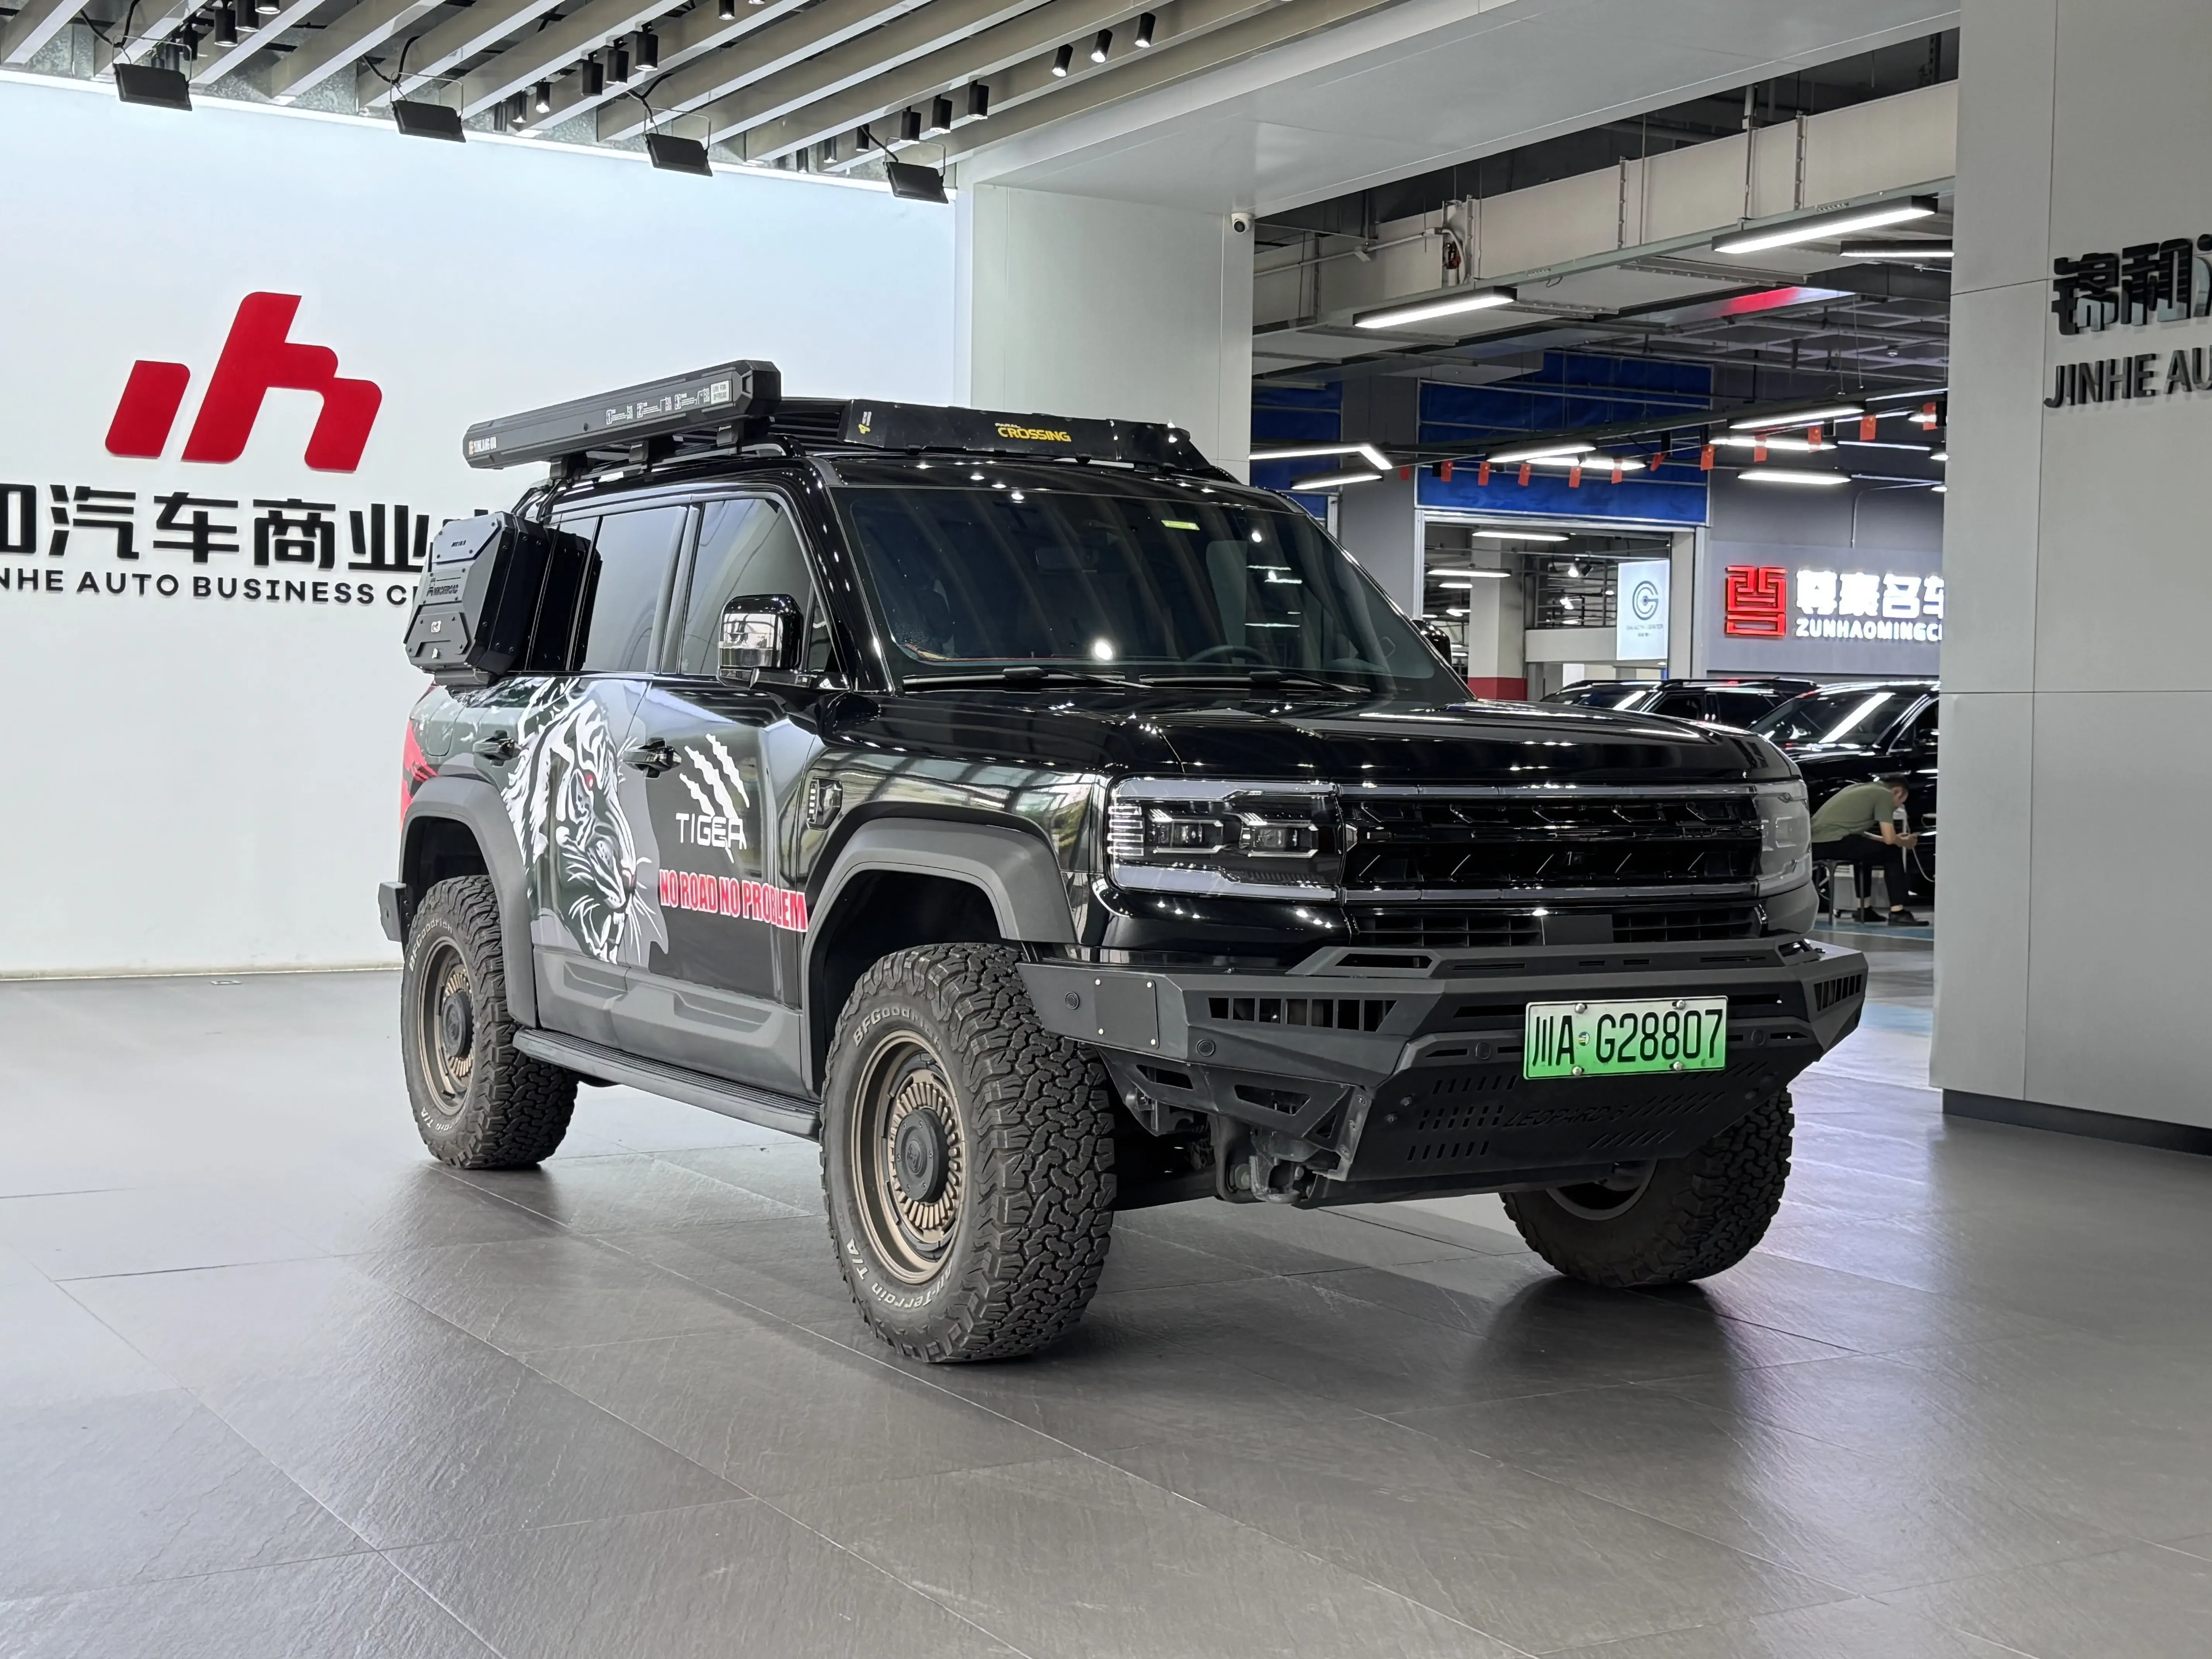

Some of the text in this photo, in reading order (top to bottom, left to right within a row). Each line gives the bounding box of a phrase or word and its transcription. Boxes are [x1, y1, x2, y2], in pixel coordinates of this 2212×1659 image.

[2044, 353, 2156, 408] JINHE
[998, 427, 1072, 442] CROSSING
[0, 483, 489, 573] 汽车商业
[77, 571, 179, 596] AUTO
[193, 576, 374, 605] BUSINESS
[386, 584, 419, 606] C
[676, 812, 747, 854] TIGER
[659, 869, 808, 933] NO ROAD NO PROBLEM
[847, 1238, 868, 1280] T/A
